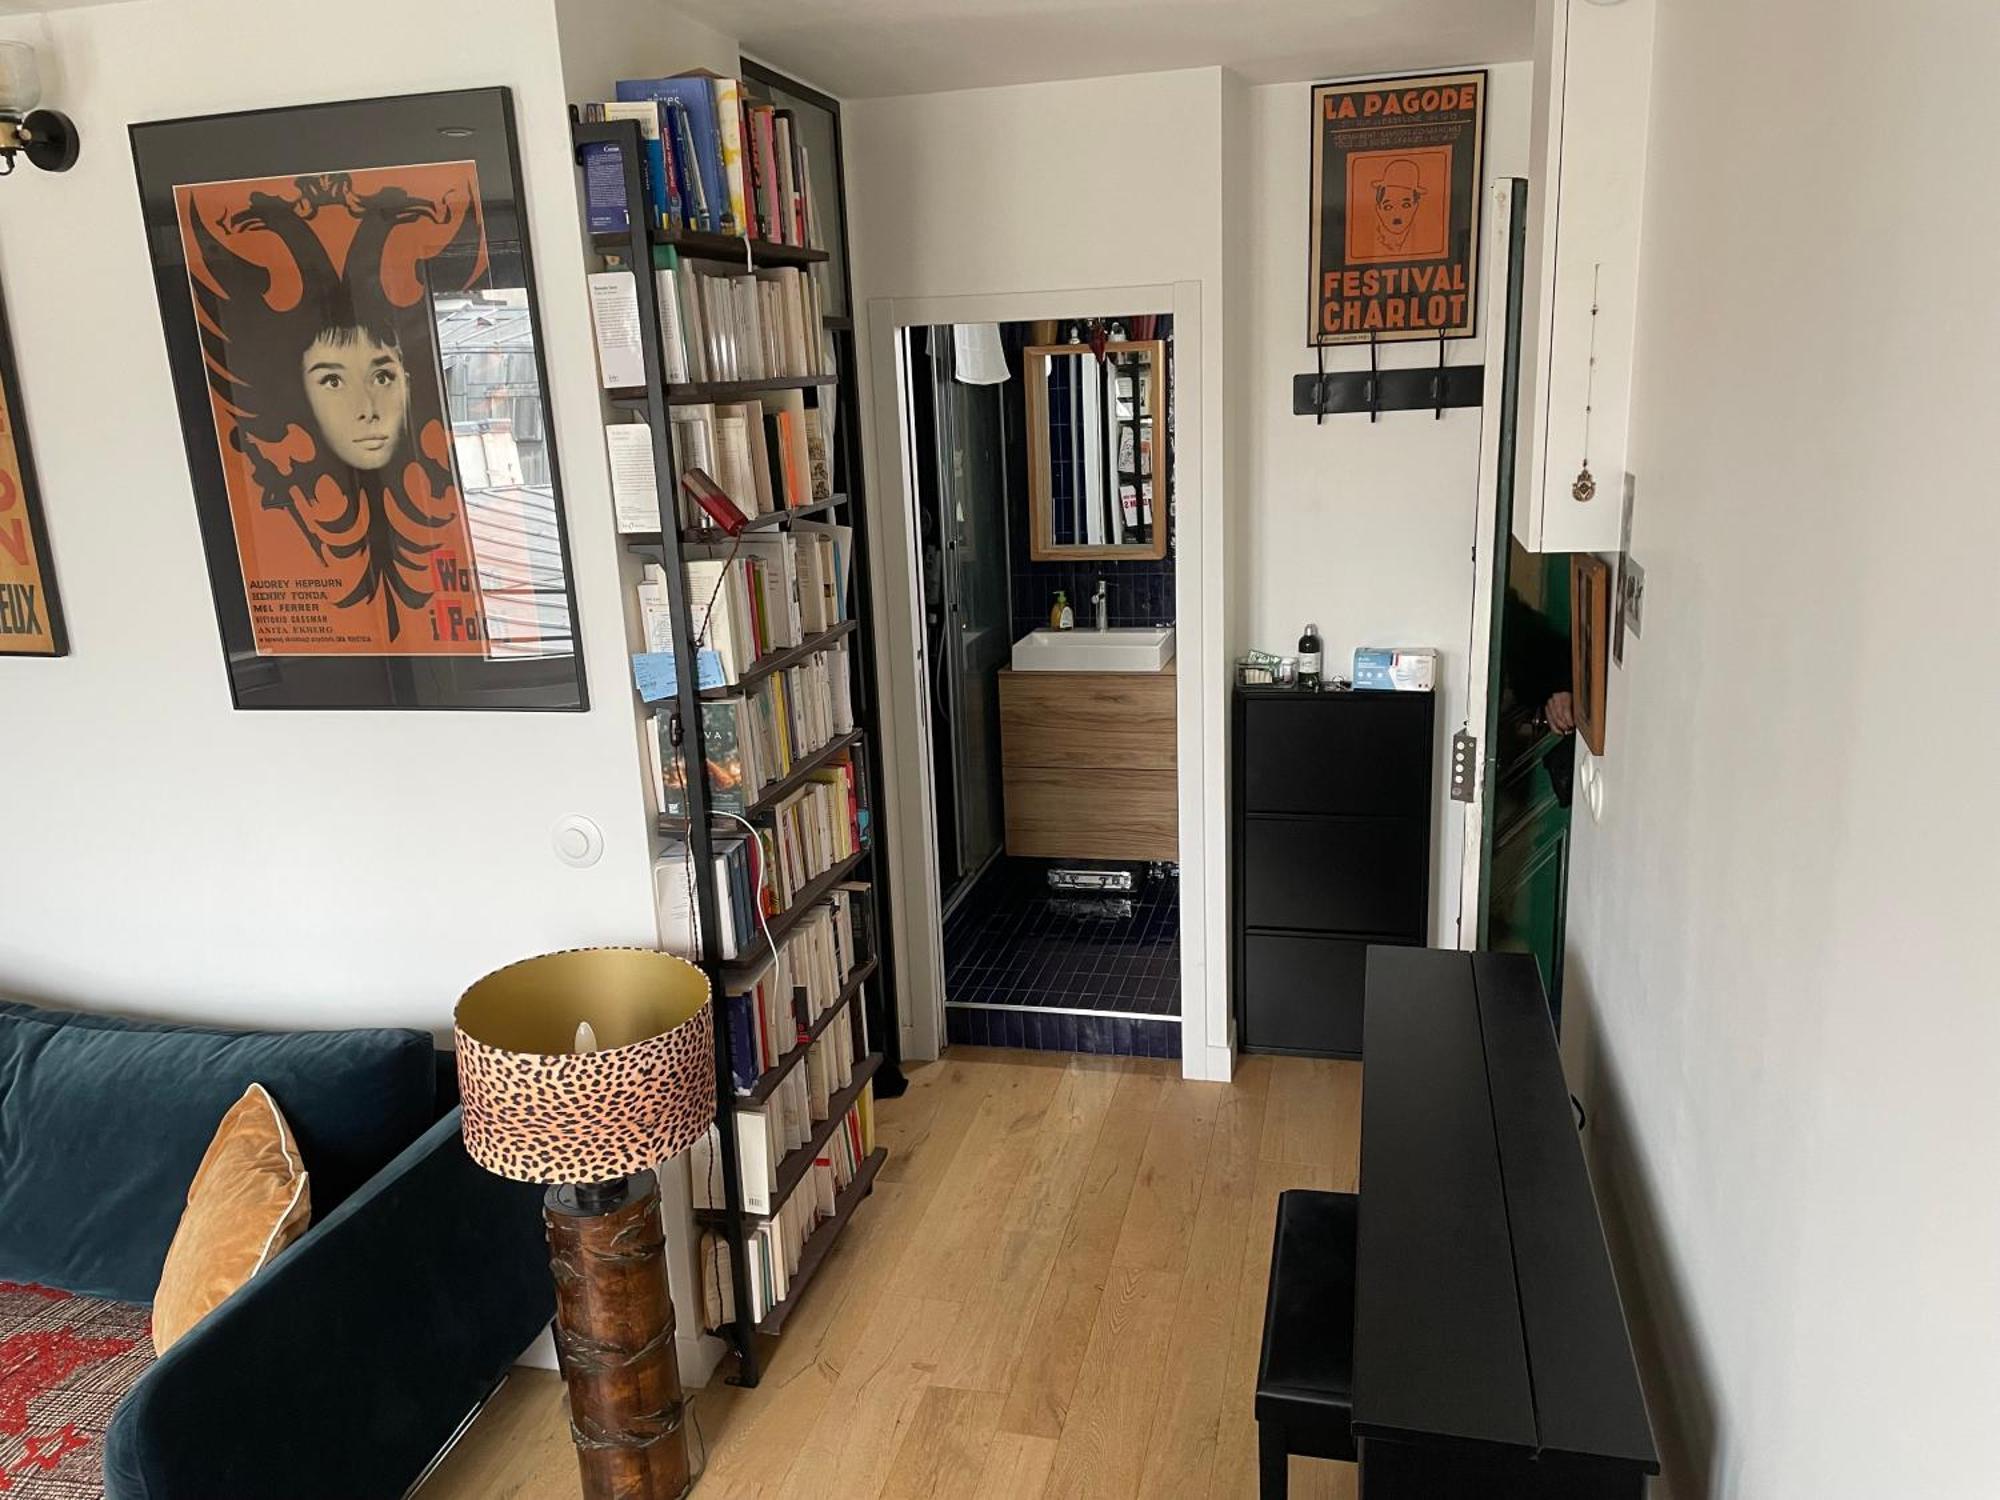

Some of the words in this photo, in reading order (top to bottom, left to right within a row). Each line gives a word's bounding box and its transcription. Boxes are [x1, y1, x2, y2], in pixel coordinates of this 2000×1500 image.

[1324, 96, 1357, 120] LA
[1364, 86, 1475, 117] PAGODE
[1324, 264, 1465, 298] FESTIVAL
[1323, 294, 1466, 332] CHARLOT
[250, 580, 289, 589] AUDREY
[295, 578, 343, 588] HEPBURN
[253, 604, 274, 613] MEL
